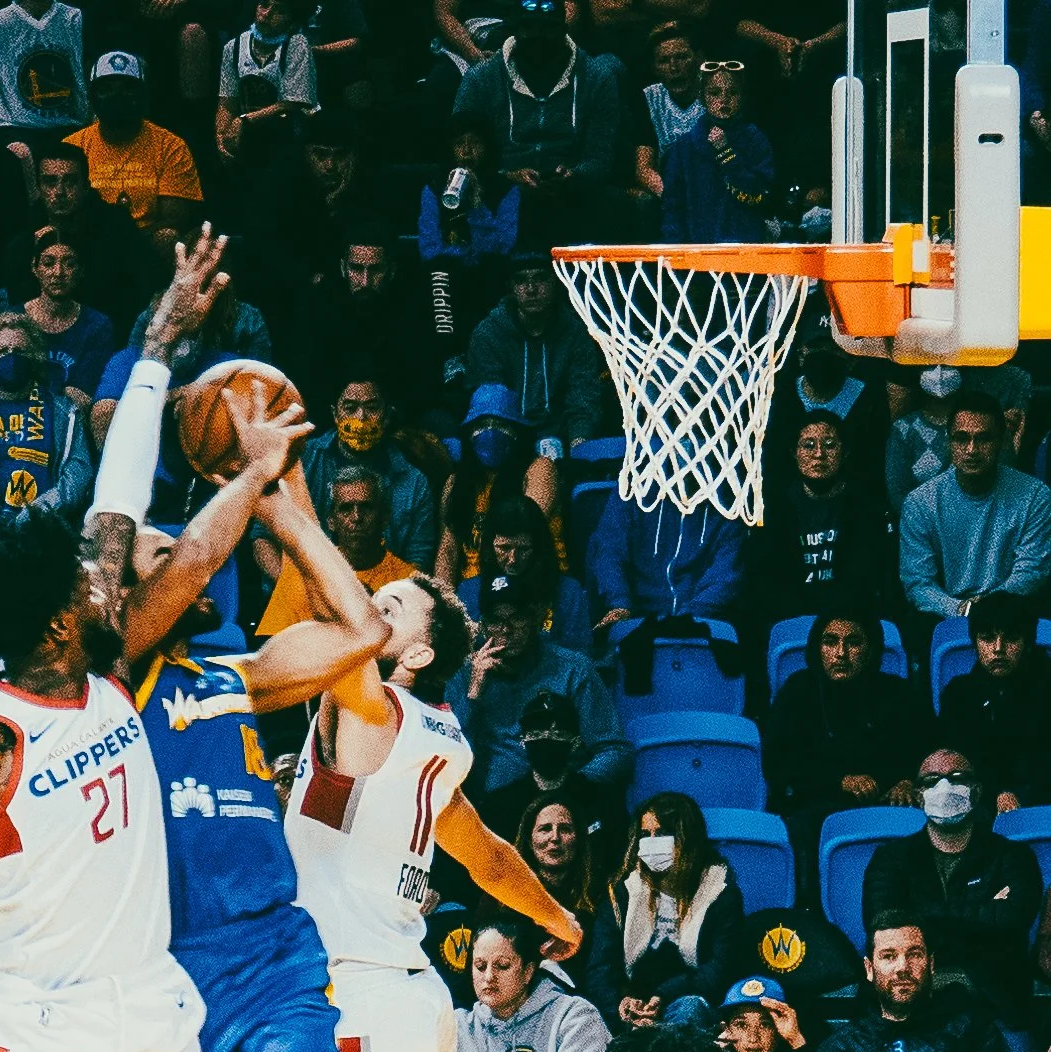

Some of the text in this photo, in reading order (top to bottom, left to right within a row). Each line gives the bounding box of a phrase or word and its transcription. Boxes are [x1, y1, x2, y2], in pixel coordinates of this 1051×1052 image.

[431, 271, 453, 333] DRIPPIN
[28, 716, 140, 798] CLIPPERS
[80, 763, 129, 844] 27
[397, 863, 430, 903] FORD
